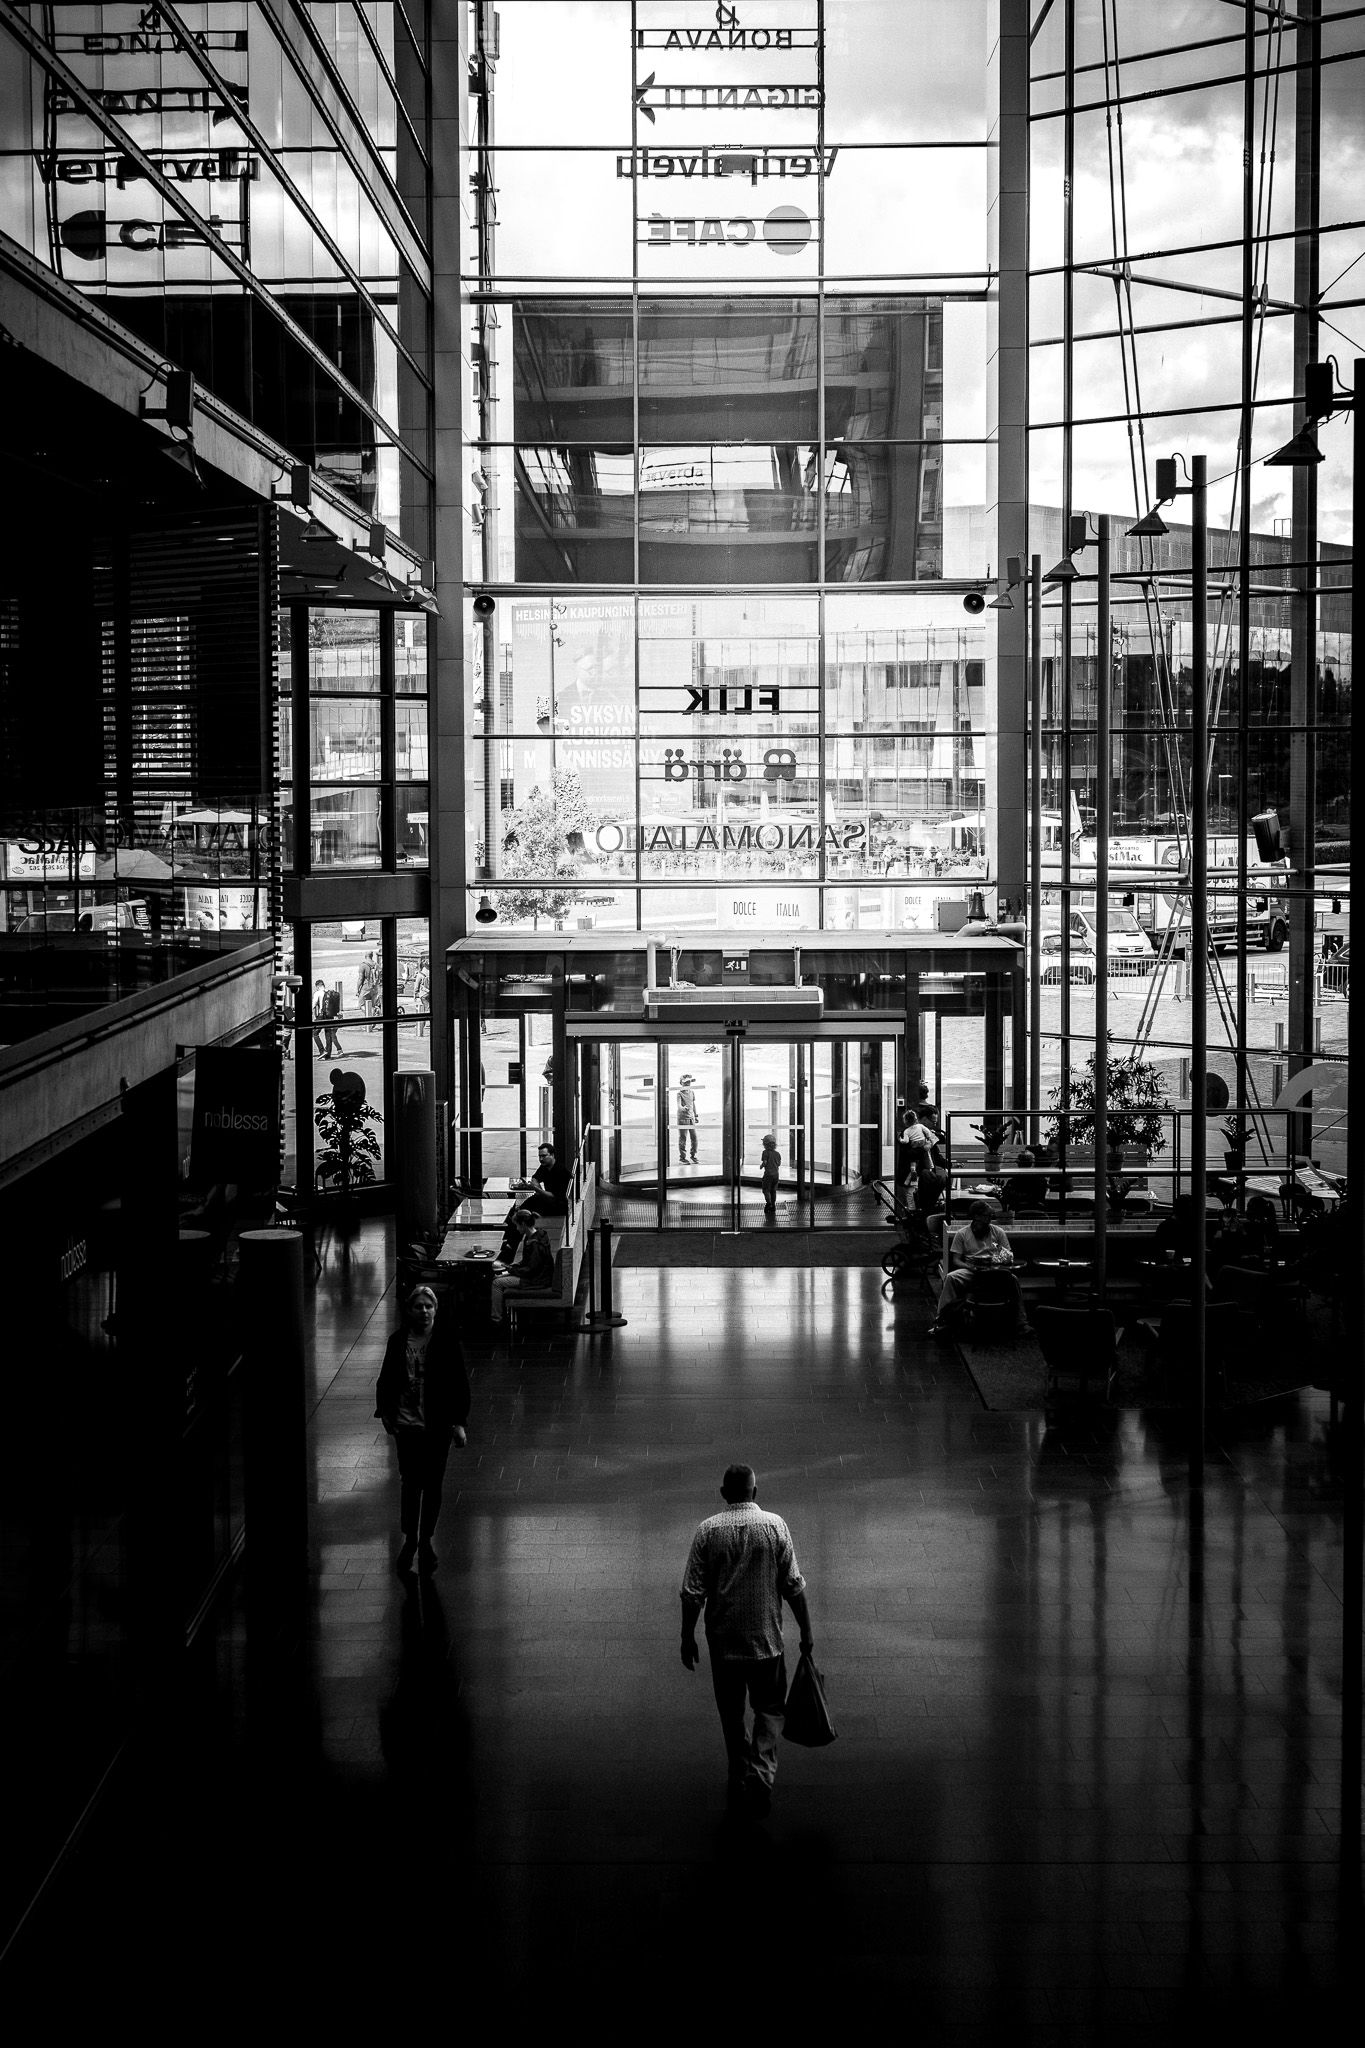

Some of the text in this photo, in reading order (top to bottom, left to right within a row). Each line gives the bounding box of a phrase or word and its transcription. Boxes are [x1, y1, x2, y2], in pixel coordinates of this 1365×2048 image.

[570, 704, 635, 725] SYKSYN
[733, 901, 800, 917] DOLCE ITALIA
[904, 896, 922, 905] DOLCE
[204, 1106, 269, 1131] noblessa
